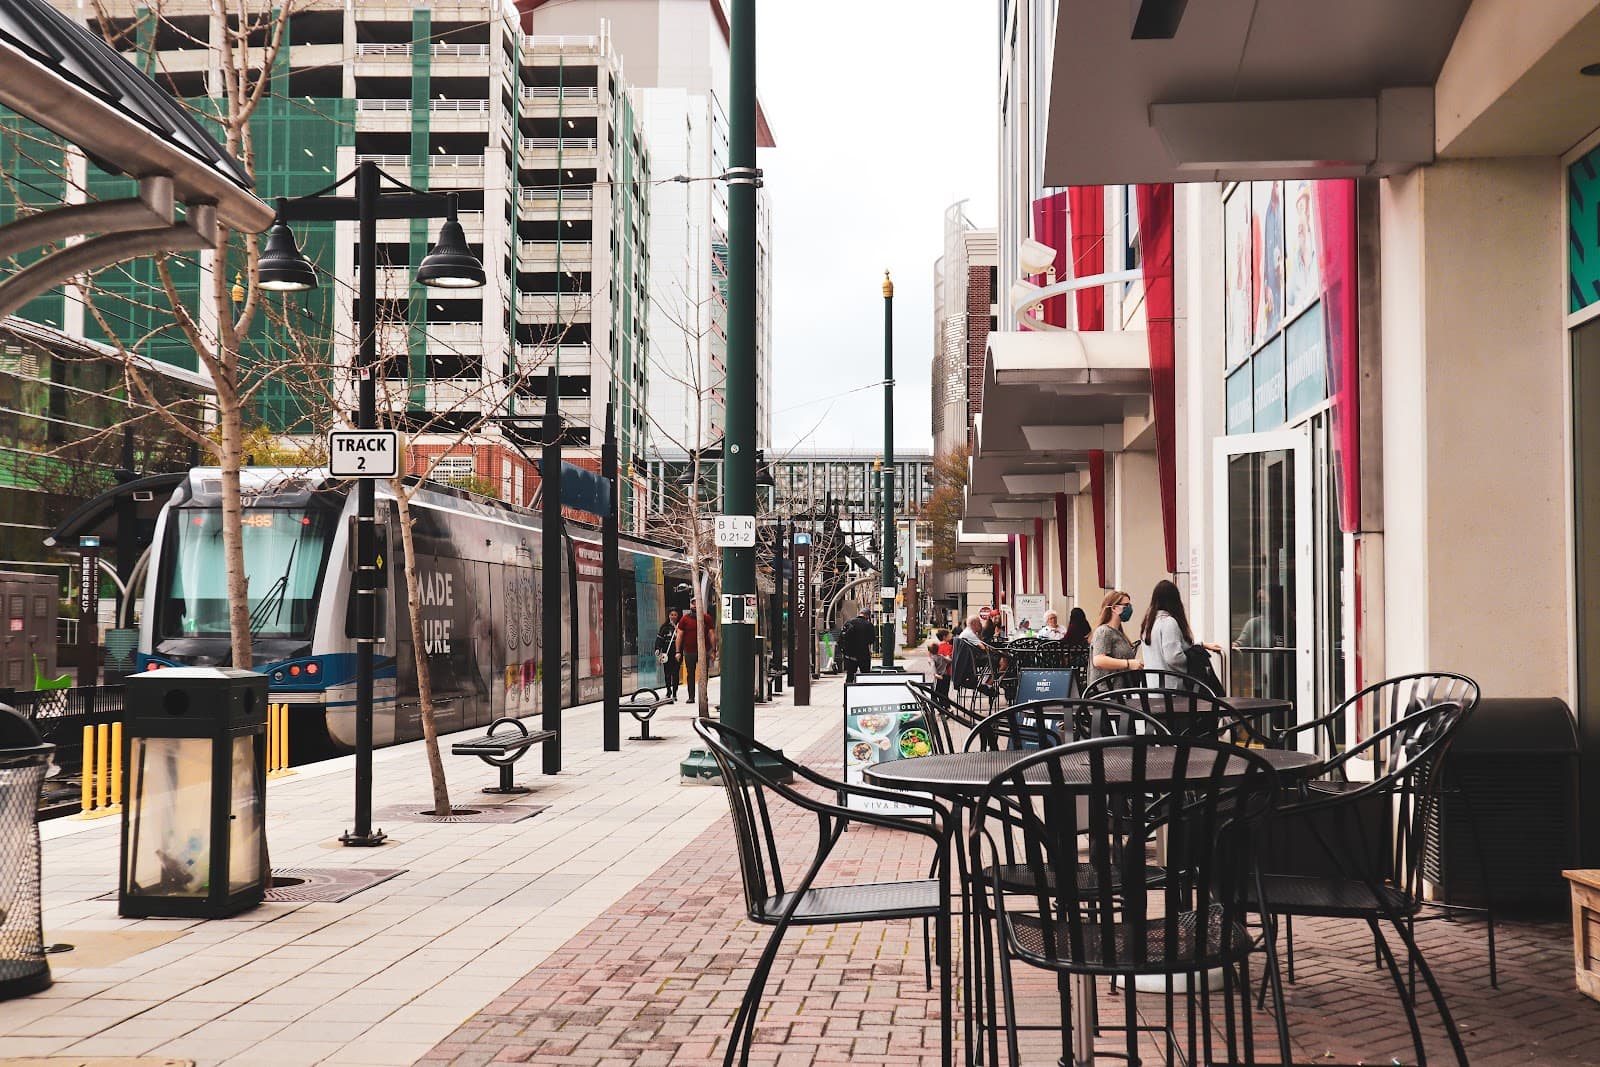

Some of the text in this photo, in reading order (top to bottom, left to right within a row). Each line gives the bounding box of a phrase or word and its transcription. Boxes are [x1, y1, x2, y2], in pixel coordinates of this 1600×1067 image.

[336, 438, 387, 452] TRACK
[357, 456, 366, 470] 2
[82, 556, 90, 614] EMERGENCY
[797, 555, 806, 618] EMERGENCY
[863, 801, 889, 809] VIVA
